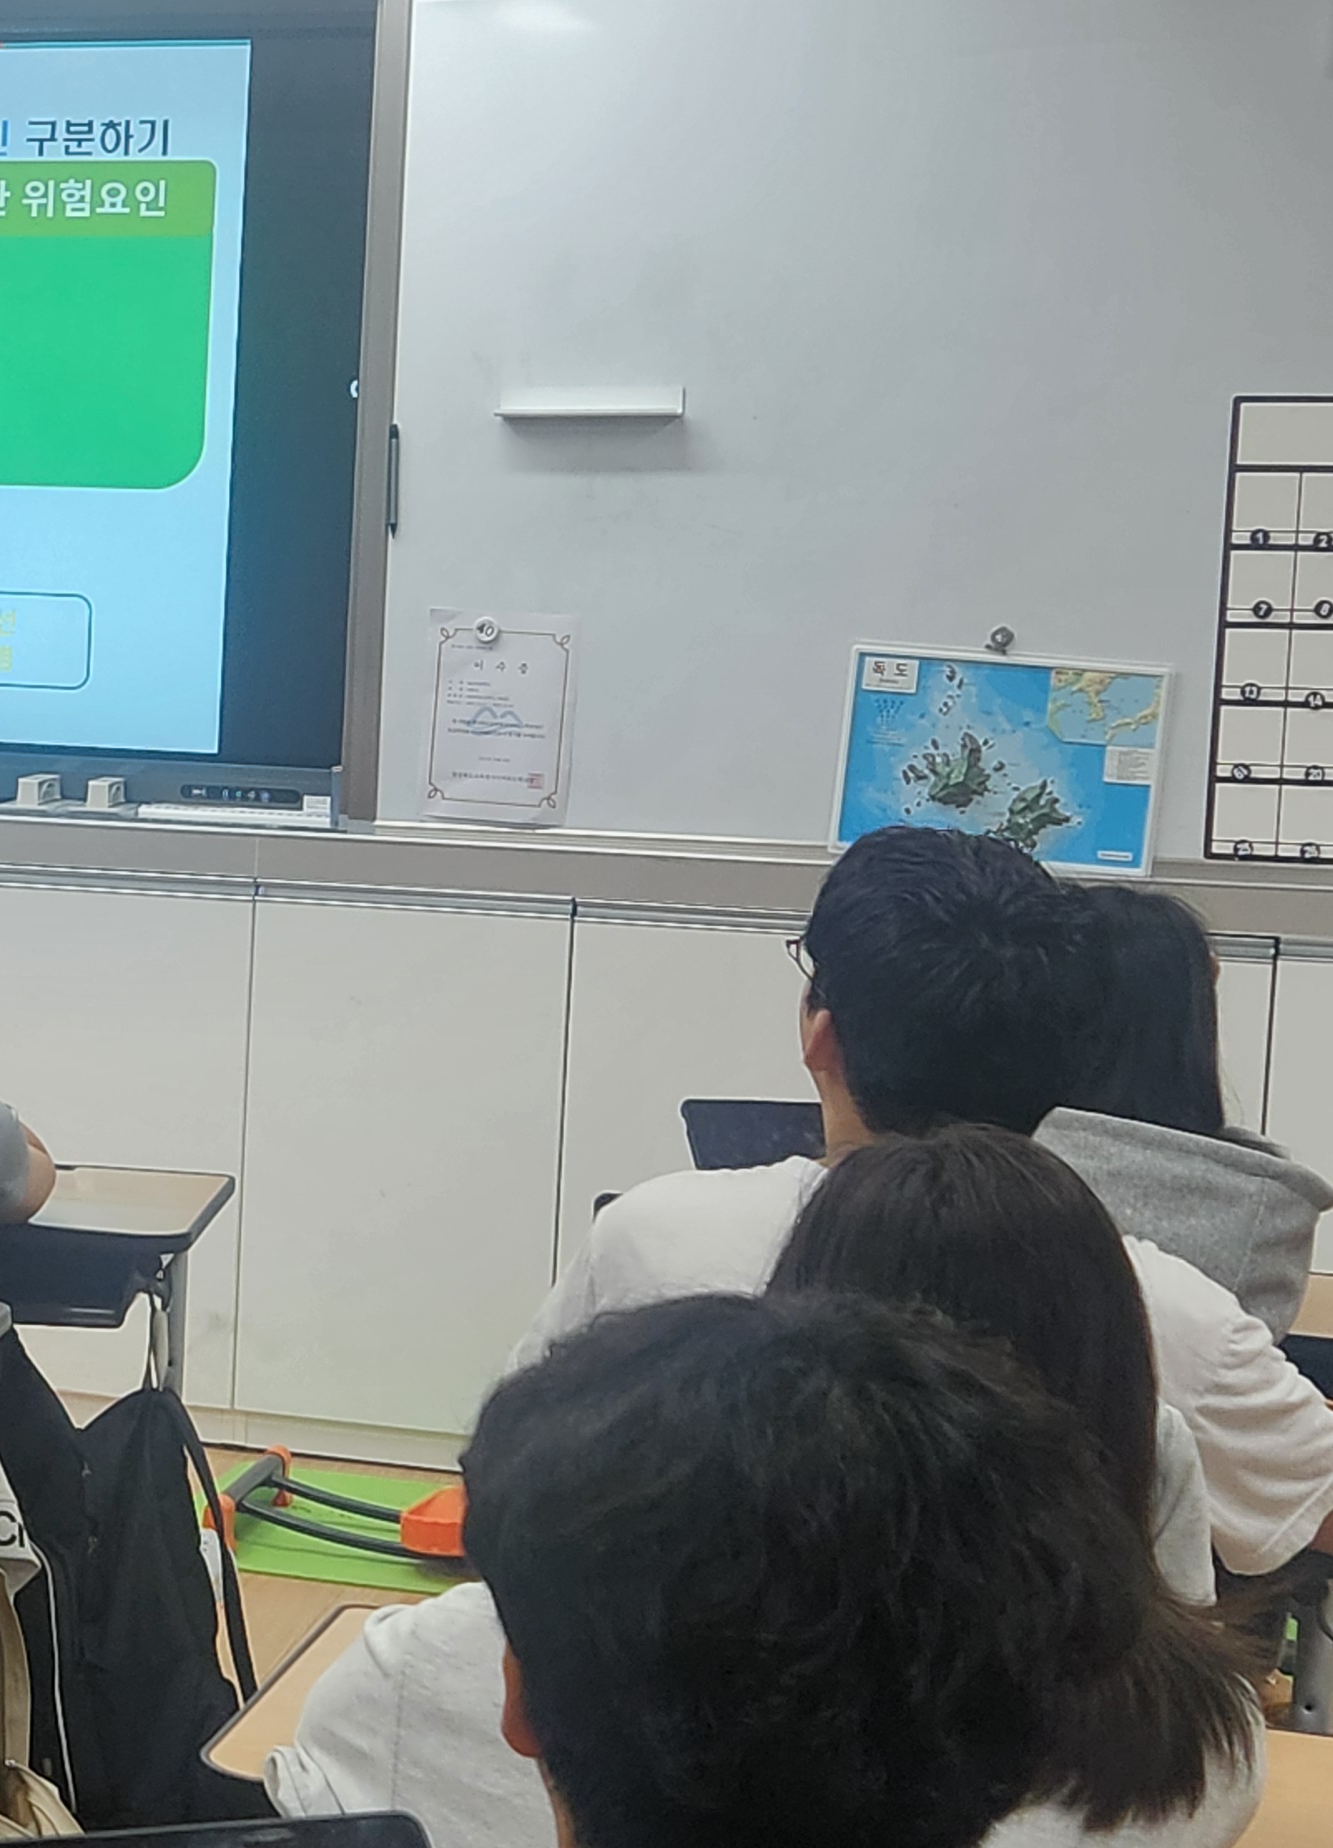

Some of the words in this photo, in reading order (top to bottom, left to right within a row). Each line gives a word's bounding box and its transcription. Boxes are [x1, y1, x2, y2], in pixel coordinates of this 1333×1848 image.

[26, 119, 170, 158] 구분하기
[21, 179, 167, 219] 위험요인
[1318, 534, 1329, 548] 2
[1258, 603, 1268, 616] 7
[1319, 603, 1331, 616] 8
